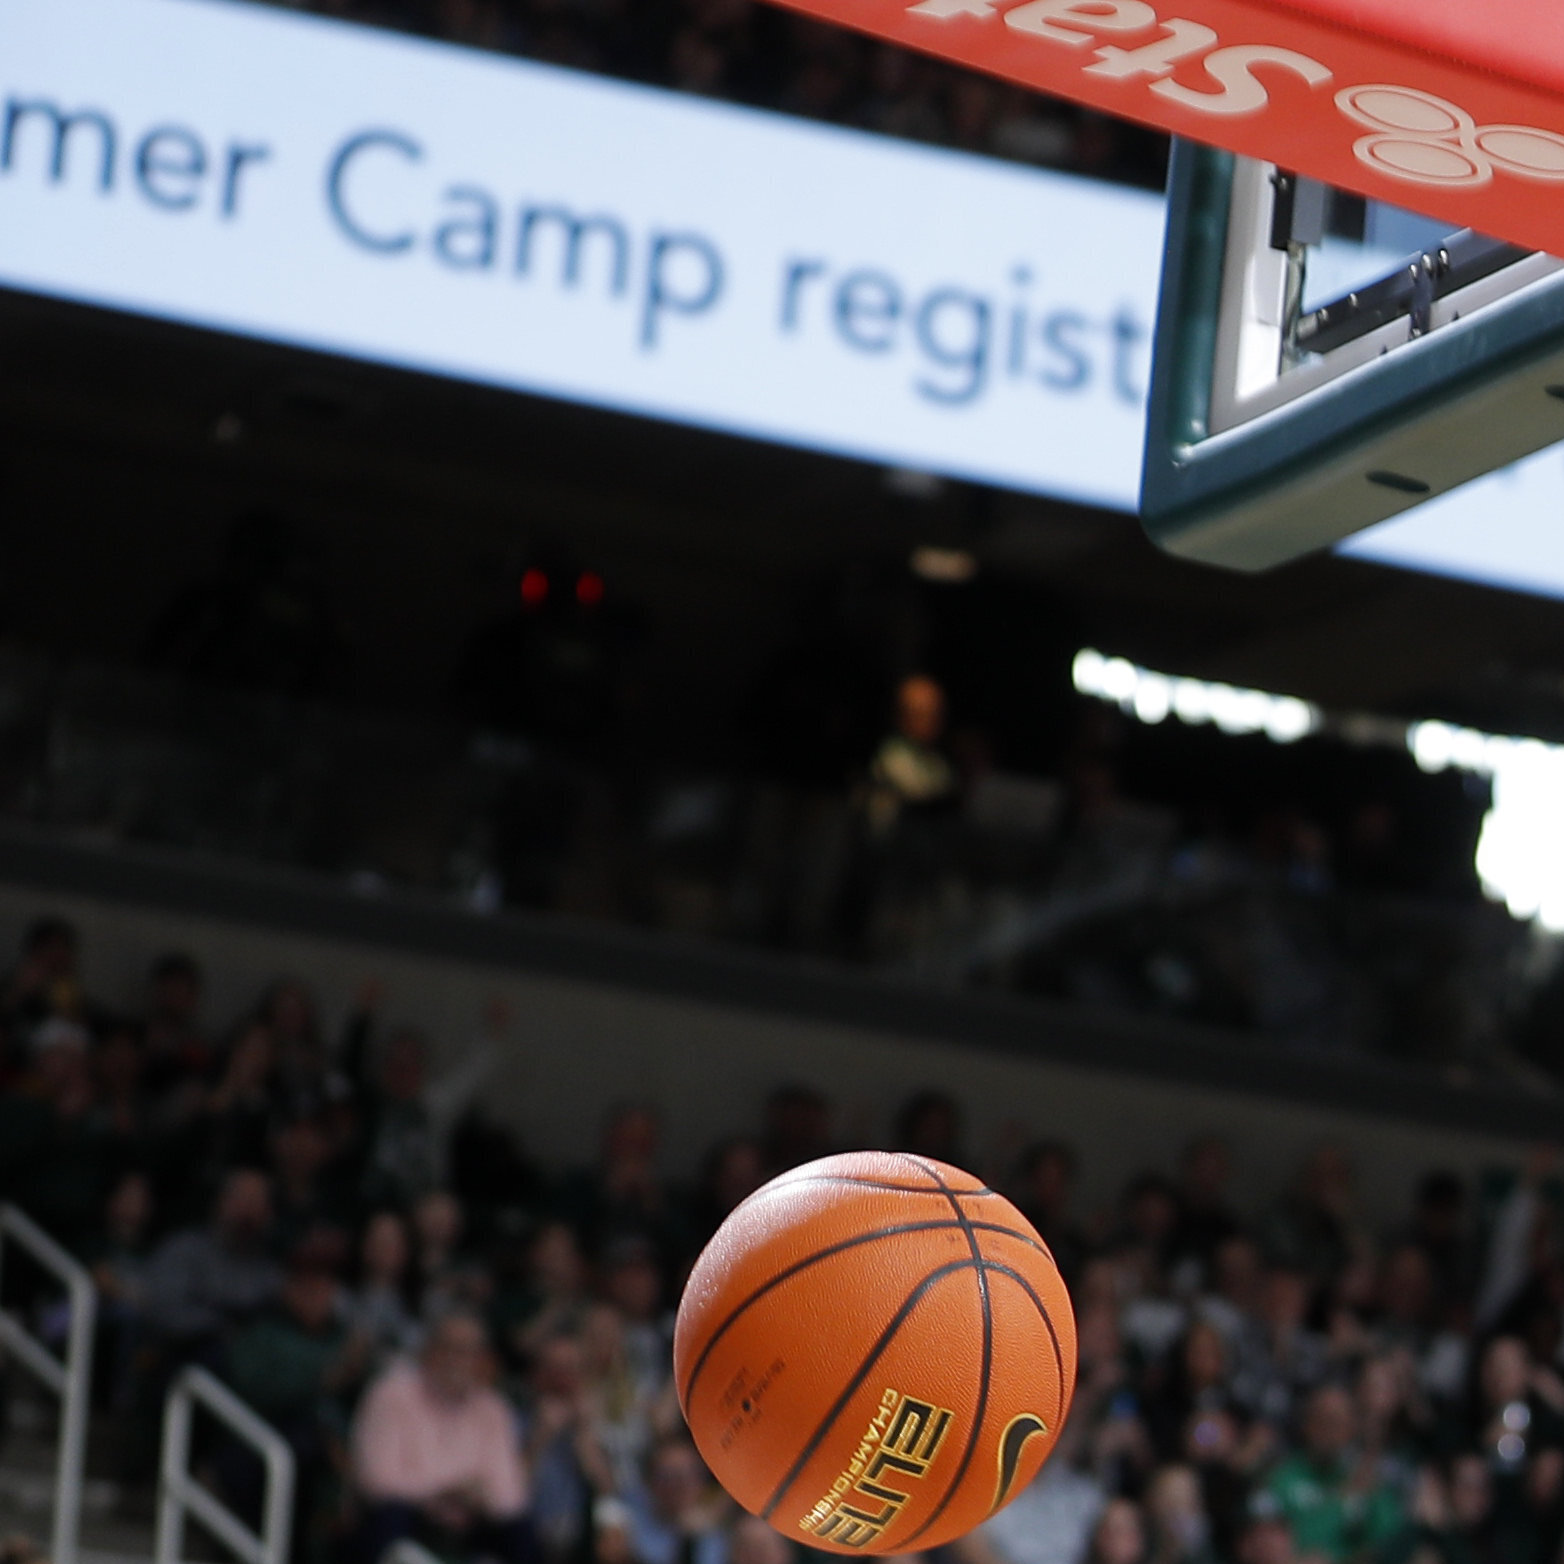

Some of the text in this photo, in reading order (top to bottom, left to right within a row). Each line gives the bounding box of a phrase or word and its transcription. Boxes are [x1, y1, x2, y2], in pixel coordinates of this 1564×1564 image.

[905, 0, 1333, 114] Sta
[324, 127, 726, 352] Camp
[815, 1393, 955, 1549] ELITE
